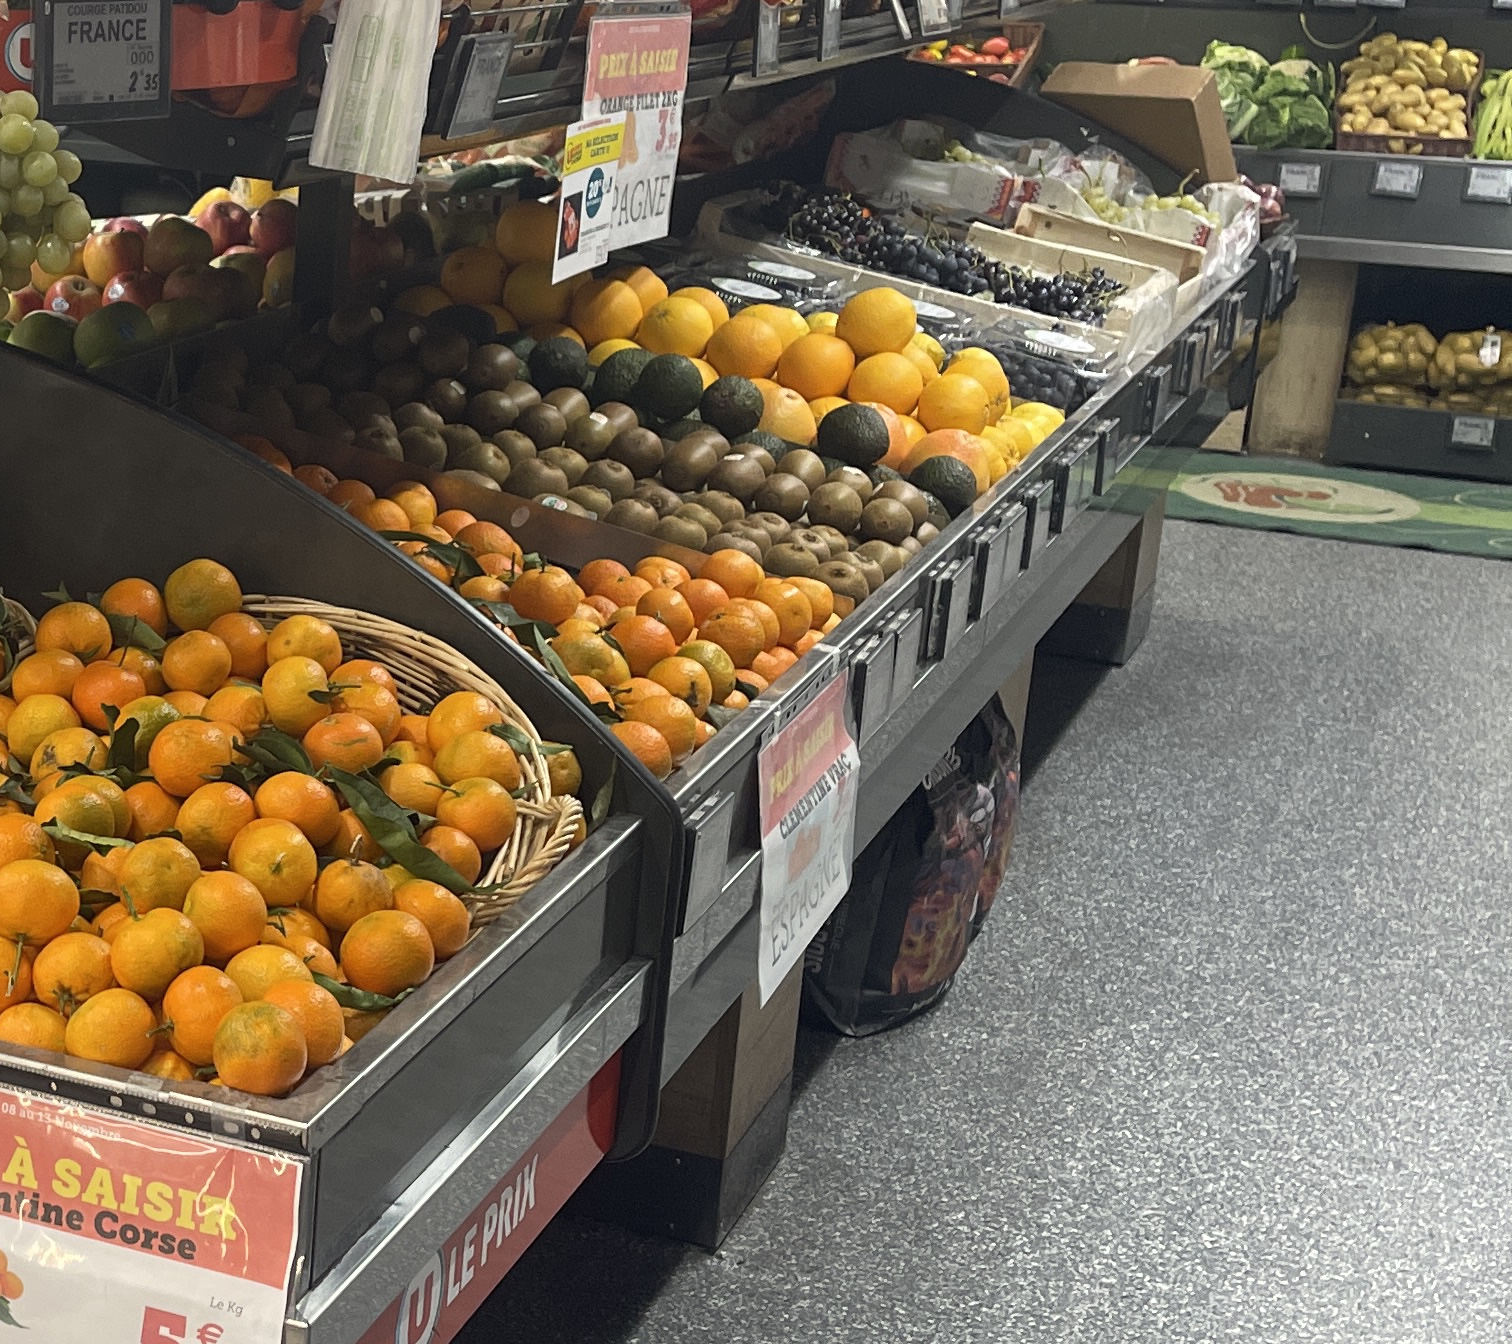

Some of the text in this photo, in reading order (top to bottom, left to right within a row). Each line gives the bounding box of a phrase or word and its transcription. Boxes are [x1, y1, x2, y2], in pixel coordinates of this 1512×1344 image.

[67, 2, 148, 16] COURGE PATIDOU
[68, 19, 148, 44] FRANCE
[131, 50, 154, 65] 000
[598, 52, 629, 79] PRIX
[610, 174, 670, 228] PAGNE
[780, 770, 832, 839] CLEMENTINE
[1, 1100, 17, 1116] 08
[19, 1107, 35, 1119] au
[2, 1136, 38, 1189] À
[52, 1157, 237, 1241] SAISIR
[94, 1211, 197, 1260] Corse
[447, 1154, 539, 1307] LE PRIX
[209, 1296, 243, 1318] Le Kg
